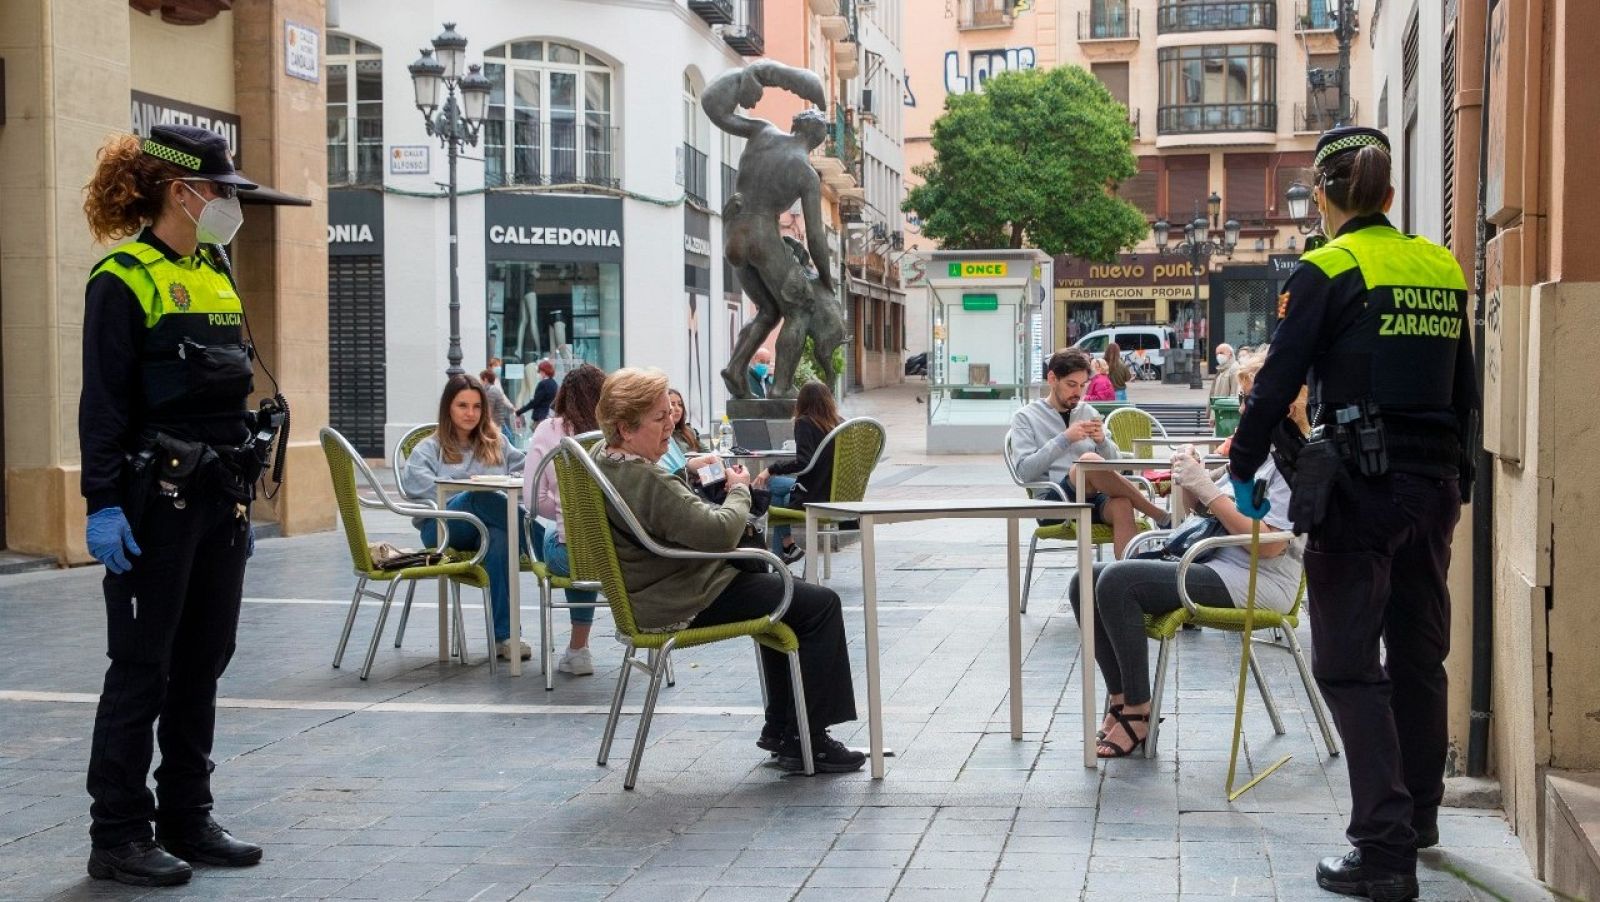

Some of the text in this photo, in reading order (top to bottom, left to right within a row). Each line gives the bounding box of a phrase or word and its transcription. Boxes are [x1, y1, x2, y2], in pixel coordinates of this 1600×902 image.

[489, 225, 621, 248] CALZEDONIA
[966, 264, 1002, 275] ONCE
[1089, 264, 1145, 279] nuevo
[1070, 287, 1192, 298] FABRICACION PROPIA
[1392, 288, 1459, 312] POLICIA
[208, 313, 242, 326] POLICIA
